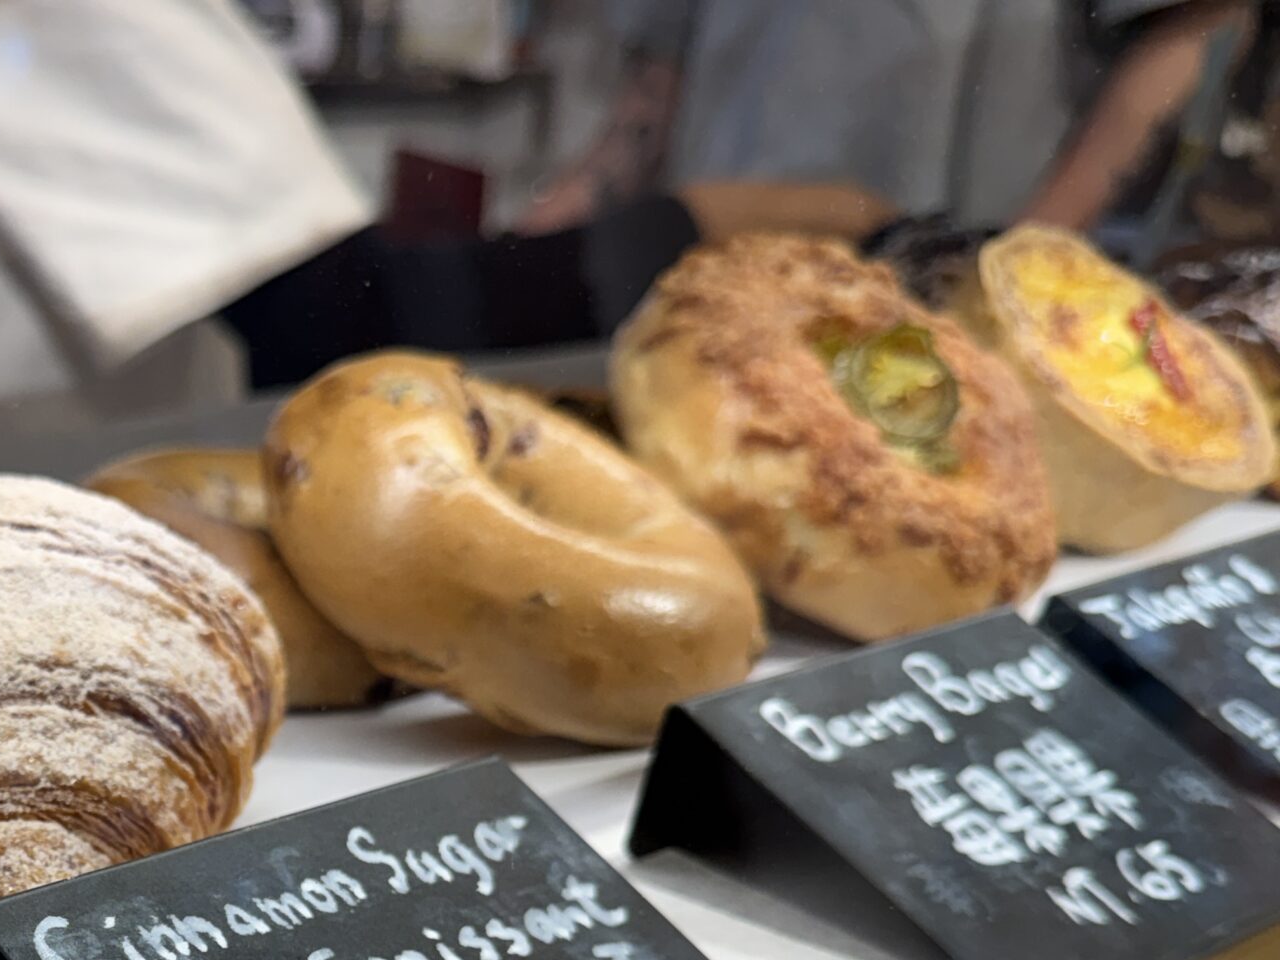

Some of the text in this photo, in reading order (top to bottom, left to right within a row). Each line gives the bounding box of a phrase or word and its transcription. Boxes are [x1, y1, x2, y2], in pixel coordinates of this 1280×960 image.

[759, 645, 1070, 762] Berry Bagel
[347, 816, 528, 895] Sugar
[1045, 840, 1204, 925] NT.65
